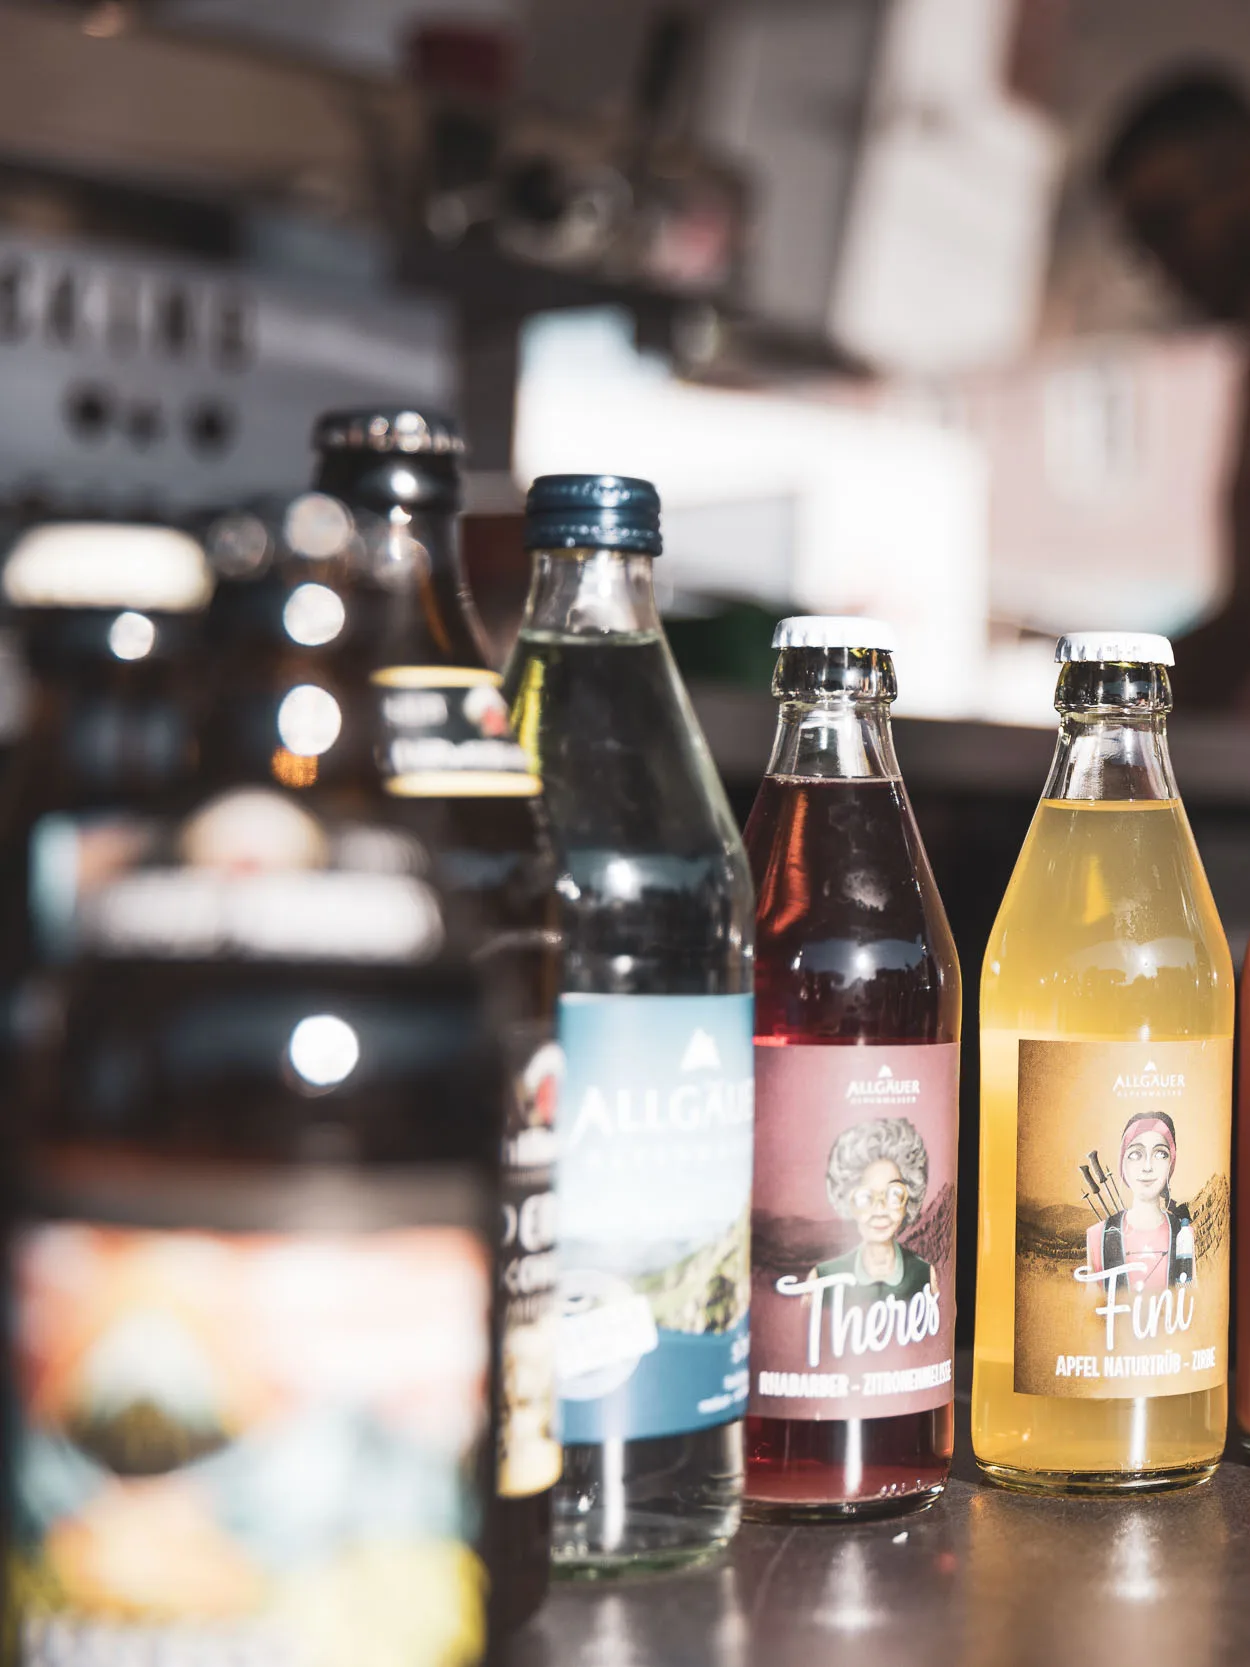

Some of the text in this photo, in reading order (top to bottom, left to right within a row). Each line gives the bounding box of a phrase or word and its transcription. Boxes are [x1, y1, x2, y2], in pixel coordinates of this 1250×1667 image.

[845, 1079, 920, 1099] ALLGÄUER
[1112, 1072, 1185, 1092] ALLGÄUER
[568, 1079, 756, 1152] ALLGÄU
[776, 1272, 940, 1367] Theres
[1074, 1262, 1194, 1350] Fini
[1055, 1354, 1100, 1377] APFEL
[1104, 1350, 1181, 1377] NATURTRÜB
